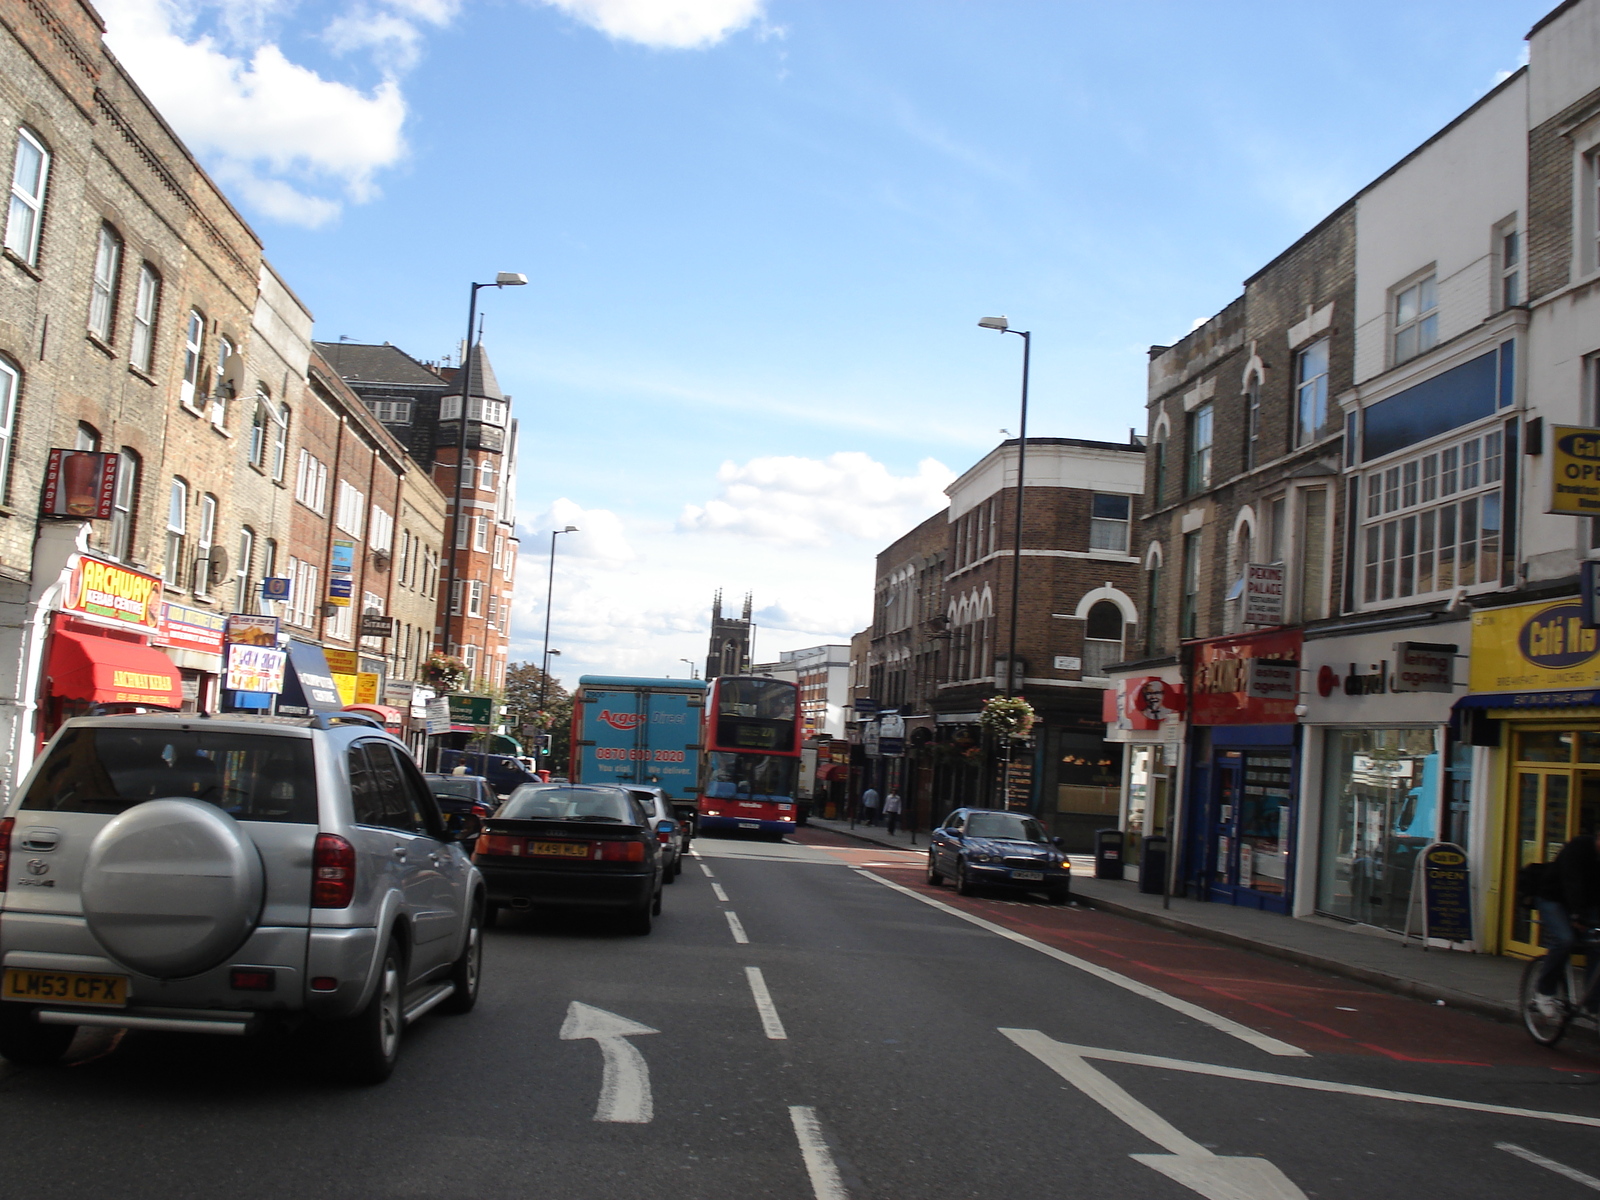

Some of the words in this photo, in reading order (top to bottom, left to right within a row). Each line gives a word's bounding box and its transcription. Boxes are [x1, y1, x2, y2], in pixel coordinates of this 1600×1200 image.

[44, 453, 60, 509] KEBABS
[101, 457, 116, 515] BURGERS
[1556, 483, 1599, 495] Breakfast
[1250, 568, 1282, 580] PEKING
[80, 561, 151, 620] ARCHWAY
[1248, 582, 1282, 595] PALACE
[86, 589, 114, 607] KEBAB
[114, 597, 143, 614] CENTRE
[1529, 616, 1564, 657] Café
[1404, 650, 1448, 672] letting
[113, 671, 149, 690] ARCHWAY
[149, 675, 172, 691] KEBAB
[1255, 668, 1292, 679] estate
[1344, 660, 1386, 695] david
[1402, 671, 1449, 687] agents
[1253, 682, 1292, 694] agents
[279, 705, 308, 715] INTERNET
[597, 709, 648, 727] Argos
[651, 711, 687, 725] Direct
[596, 747, 627, 760] 0870
[629, 749, 652, 761] 600
[654, 750, 685, 762] 2020
[598, 764, 613, 772] You
[662, 766, 692, 775] deliver.
[18, 877, 55, 888] RAV4
[1428, 871, 1465, 880] OPEN
[12, 973, 68, 997] LM53
[74, 977, 118, 1000] CFX
